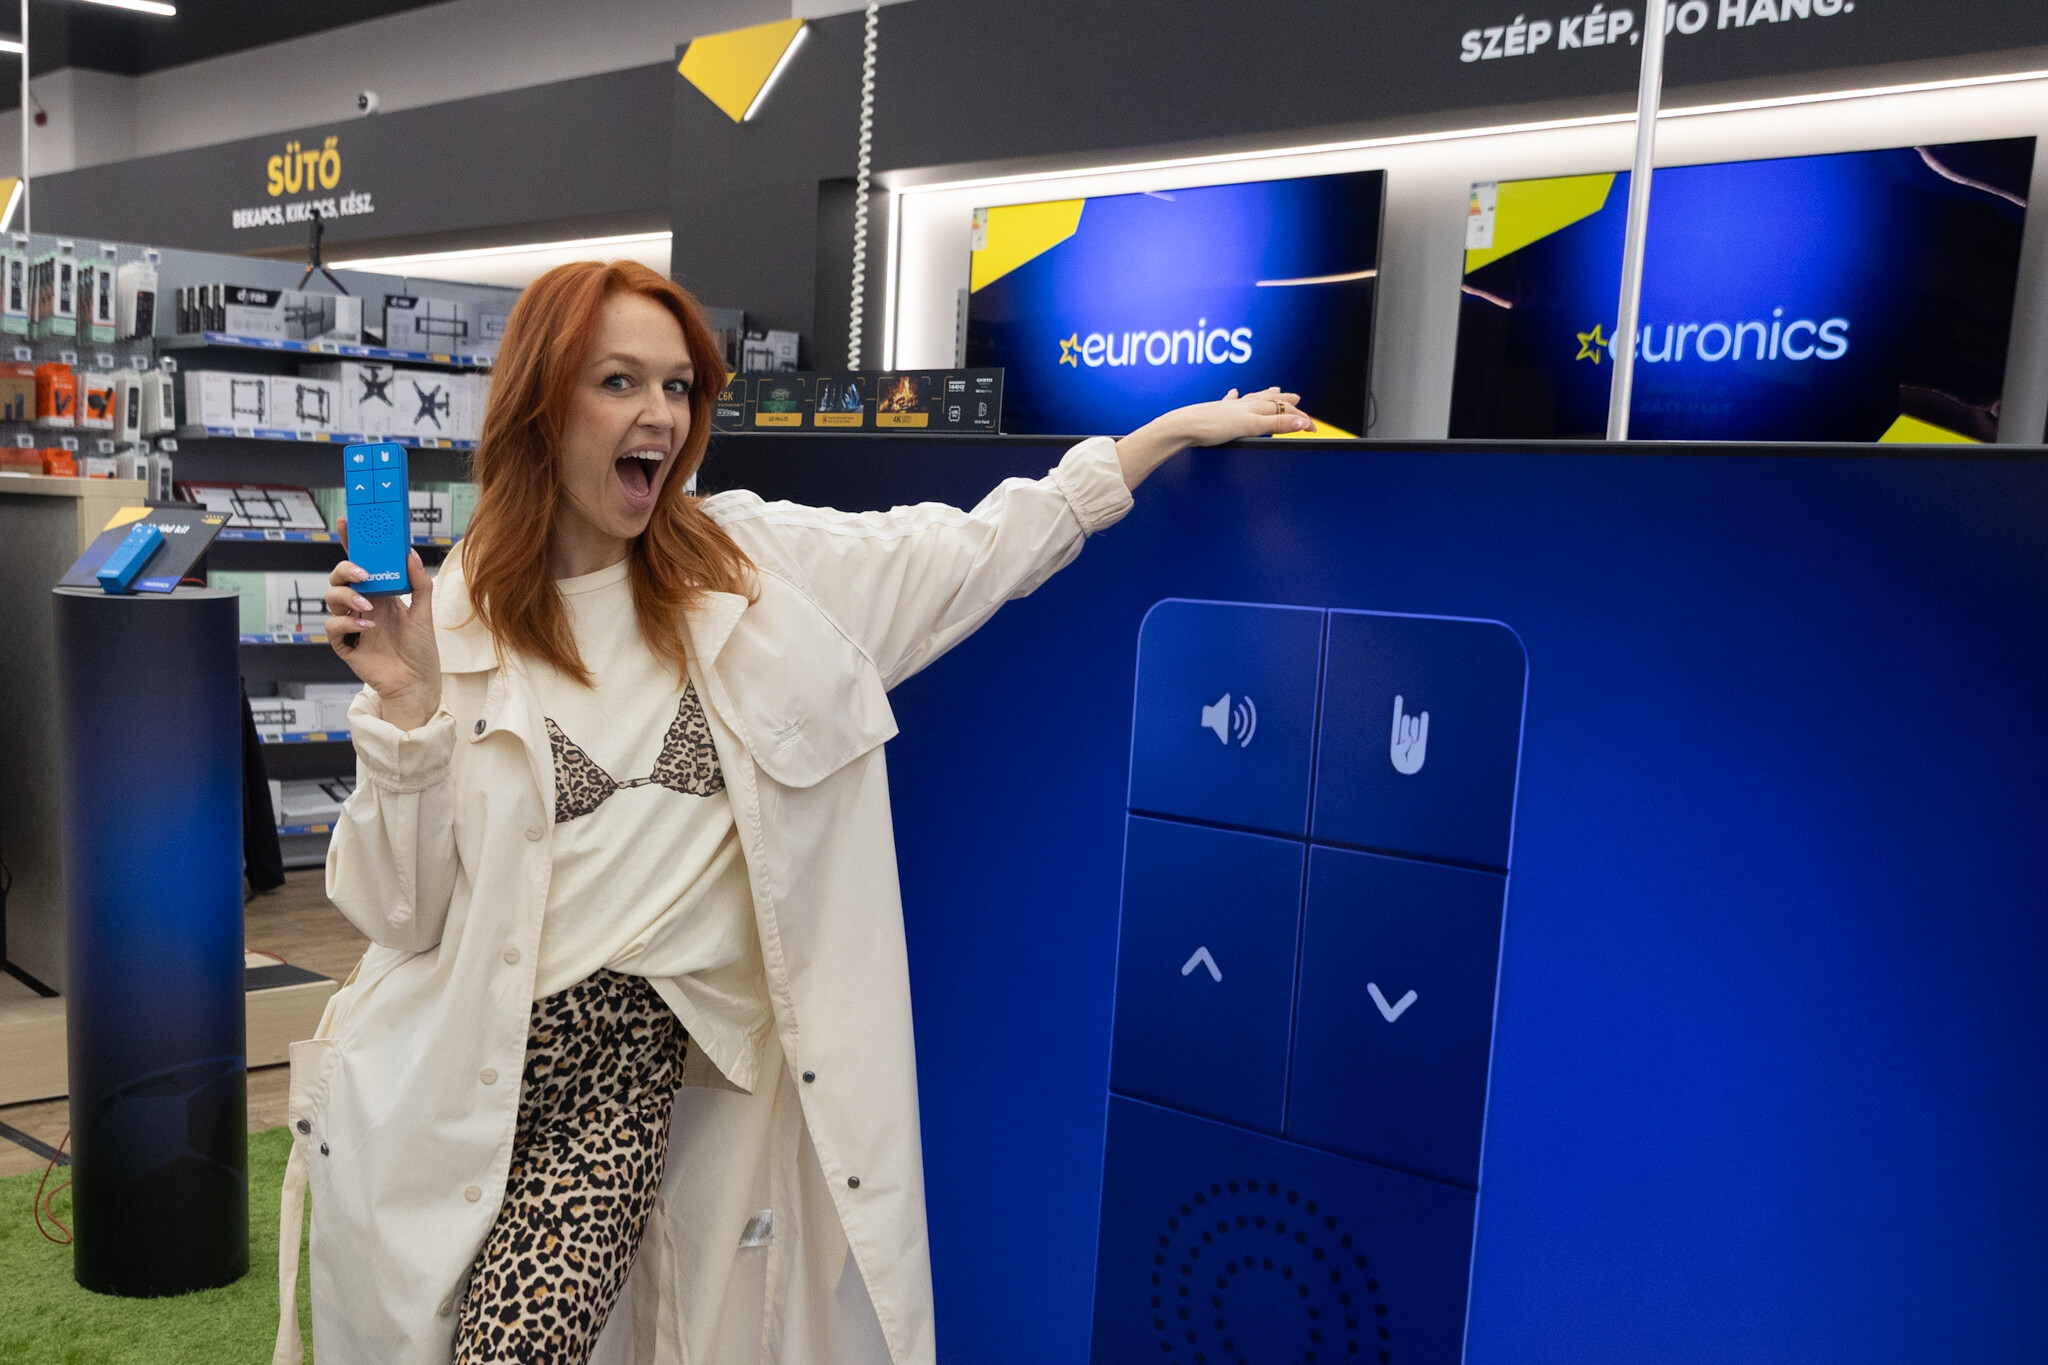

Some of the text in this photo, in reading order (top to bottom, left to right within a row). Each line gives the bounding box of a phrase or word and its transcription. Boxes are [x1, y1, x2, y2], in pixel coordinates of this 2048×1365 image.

[1460, 14, 1553, 63] SZÉP
[1558, 3, 1639, 49] KÉP,
[267, 136, 341, 197] SÜTŐ
[232, 206, 285, 228] BEKAPCS,
[340, 191, 375, 215] KÉSZ.
[1082, 316, 1252, 368] euronics
[363, 571, 401, 582] uronics
